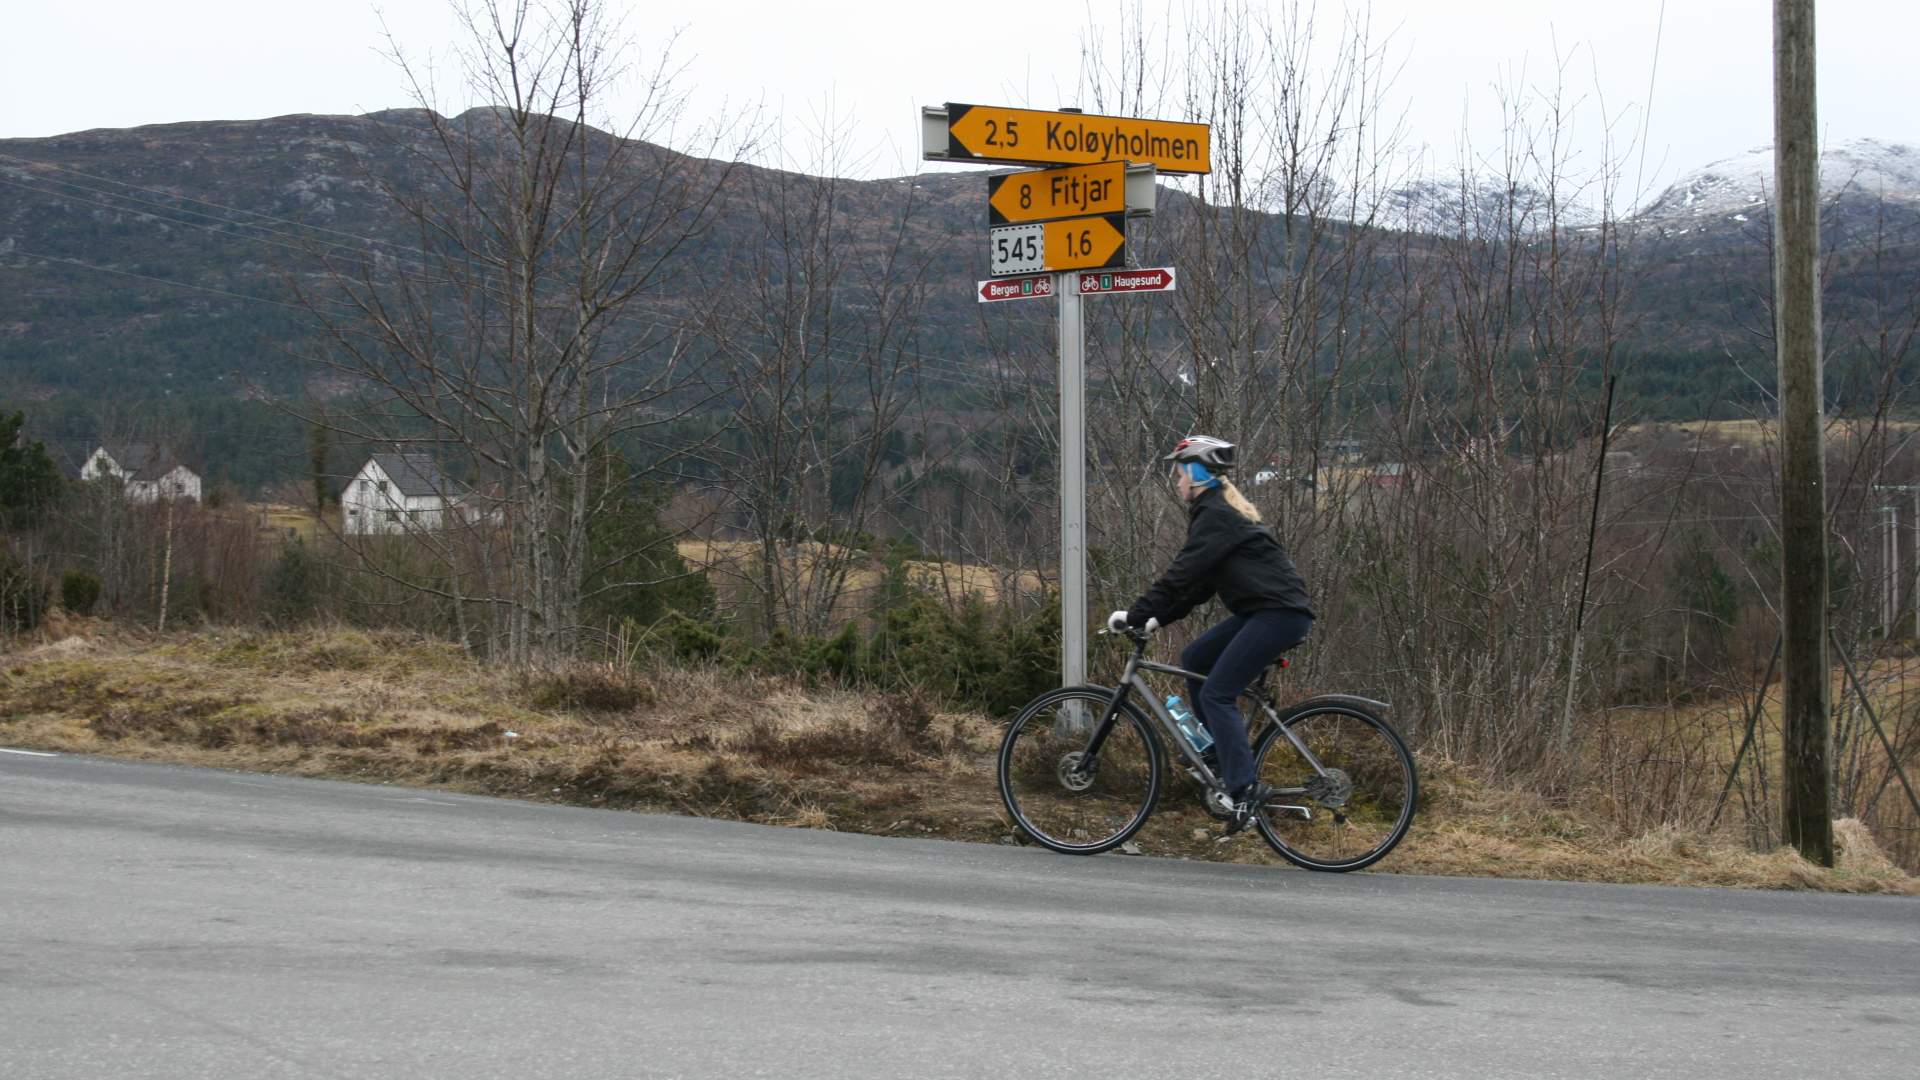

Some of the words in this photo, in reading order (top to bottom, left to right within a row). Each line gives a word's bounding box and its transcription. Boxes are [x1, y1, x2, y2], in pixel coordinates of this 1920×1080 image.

[985, 120, 1019, 150] 2,5
[1046, 121, 1199, 161] Koløyholmen
[1020, 184, 1032, 209] 8
[1051, 175, 1112, 211] Fitjar
[998, 236, 1038, 264] 545
[1066, 230, 1092, 258] 1,6
[990, 284, 1019, 297] Bergen
[1114, 275, 1161, 289] Haugesund
